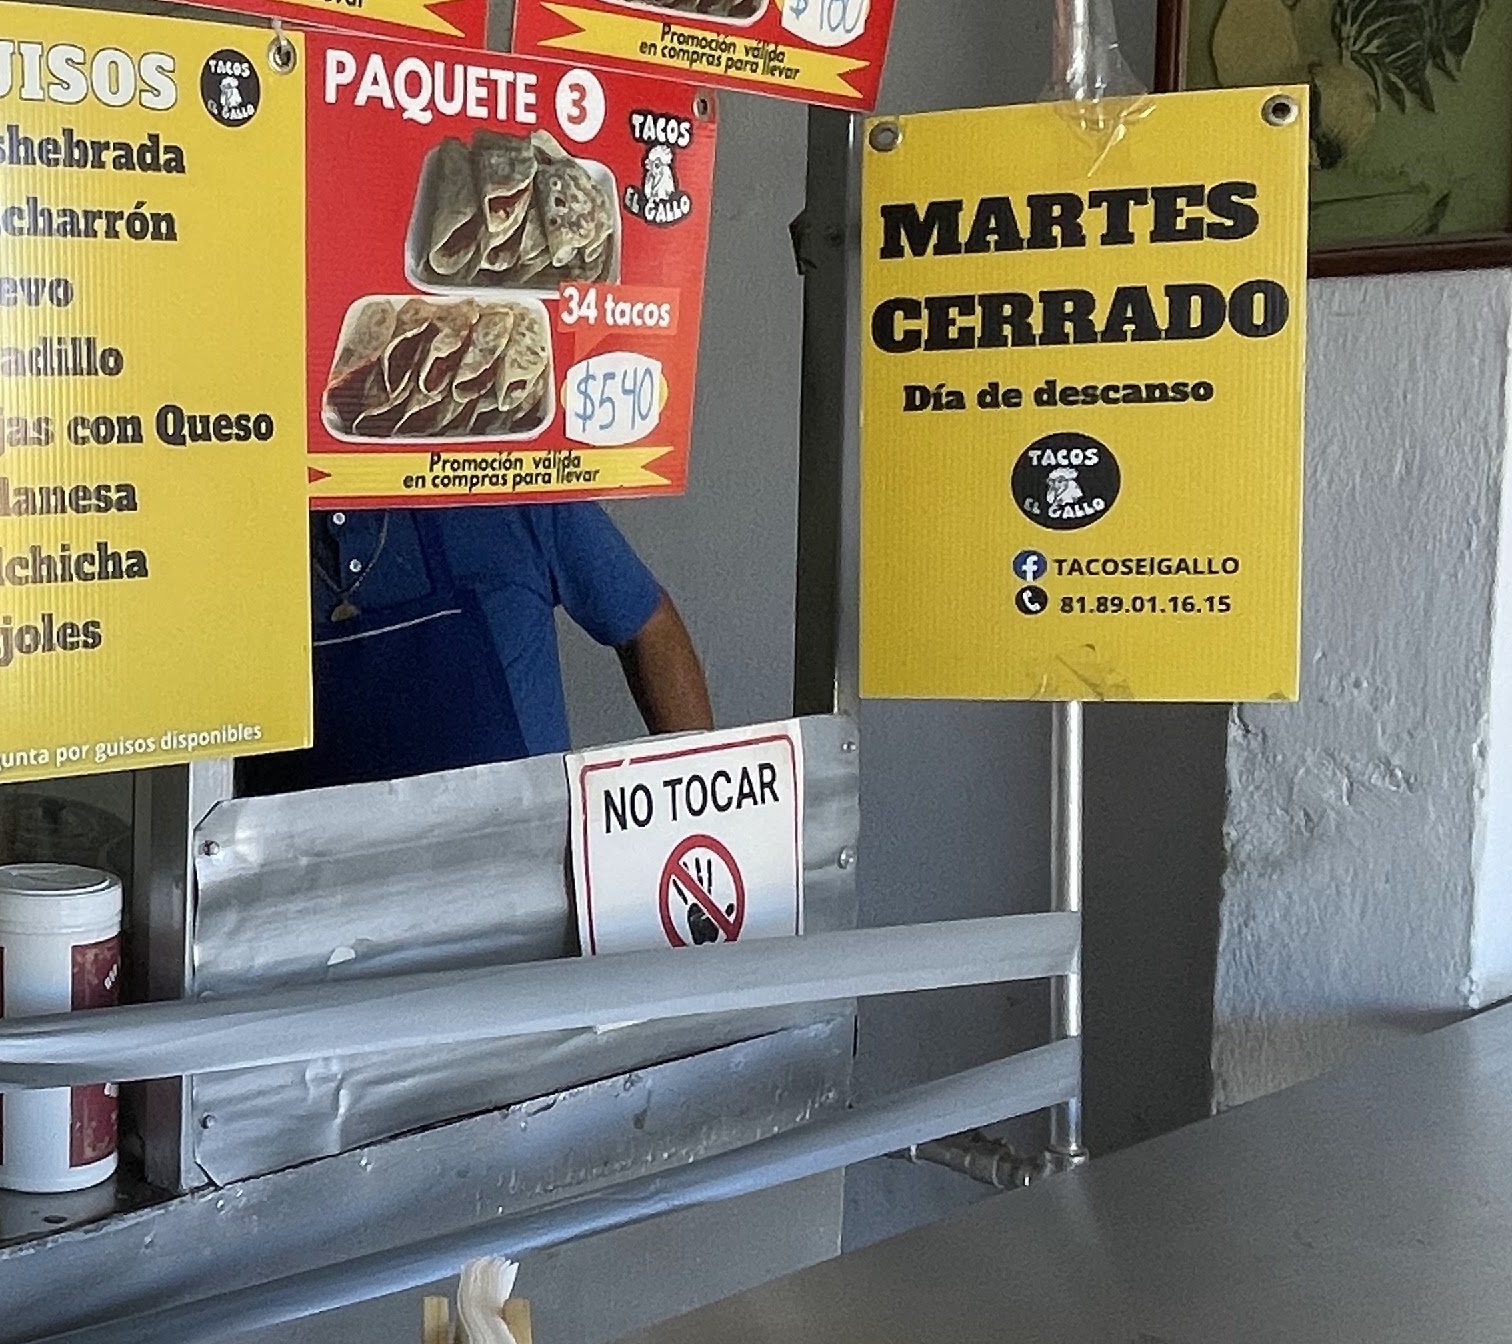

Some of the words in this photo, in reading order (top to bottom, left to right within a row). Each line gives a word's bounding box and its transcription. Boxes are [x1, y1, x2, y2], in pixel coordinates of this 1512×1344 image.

[661, 22, 736, 54] Promoción
[208, 60, 250, 77] TACOS
[639, 41, 657, 56] en
[661, 45, 721, 68] compras
[725, 56, 759, 74] para
[324, 49, 538, 124] PAQUETE
[568, 82, 587, 126] 3
[631, 114, 691, 147] TACOS
[644, 195, 690, 223] GALLO
[879, 181, 1259, 260] MARTES
[560, 287, 598, 324] 34
[604, 292, 670, 328] tacos
[871, 279, 1289, 354] CERRADO
[574, 361, 655, 433] $540
[903, 383, 965, 412] Día
[976, 381, 1023, 408] de
[1033, 379, 1215, 408] descanso
[67, 413, 143, 445] con
[155, 404, 275, 446] Queso
[429, 450, 524, 473] Promoción
[1028, 448, 1100, 466] TACOS
[402, 475, 426, 489] en
[431, 472, 508, 493] compras
[512, 470, 551, 492] para
[1024, 498, 1041, 514] EL
[1047, 497, 1106, 519] GALLO
[1060, 595, 1232, 614] 81.89.01.16.15
[56, 745, 90, 767] por
[94, 736, 156, 762] guisos
[160, 722, 262, 757] disponibles
[603, 783, 653, 834] NO
[663, 762, 779, 822] TOCAR
